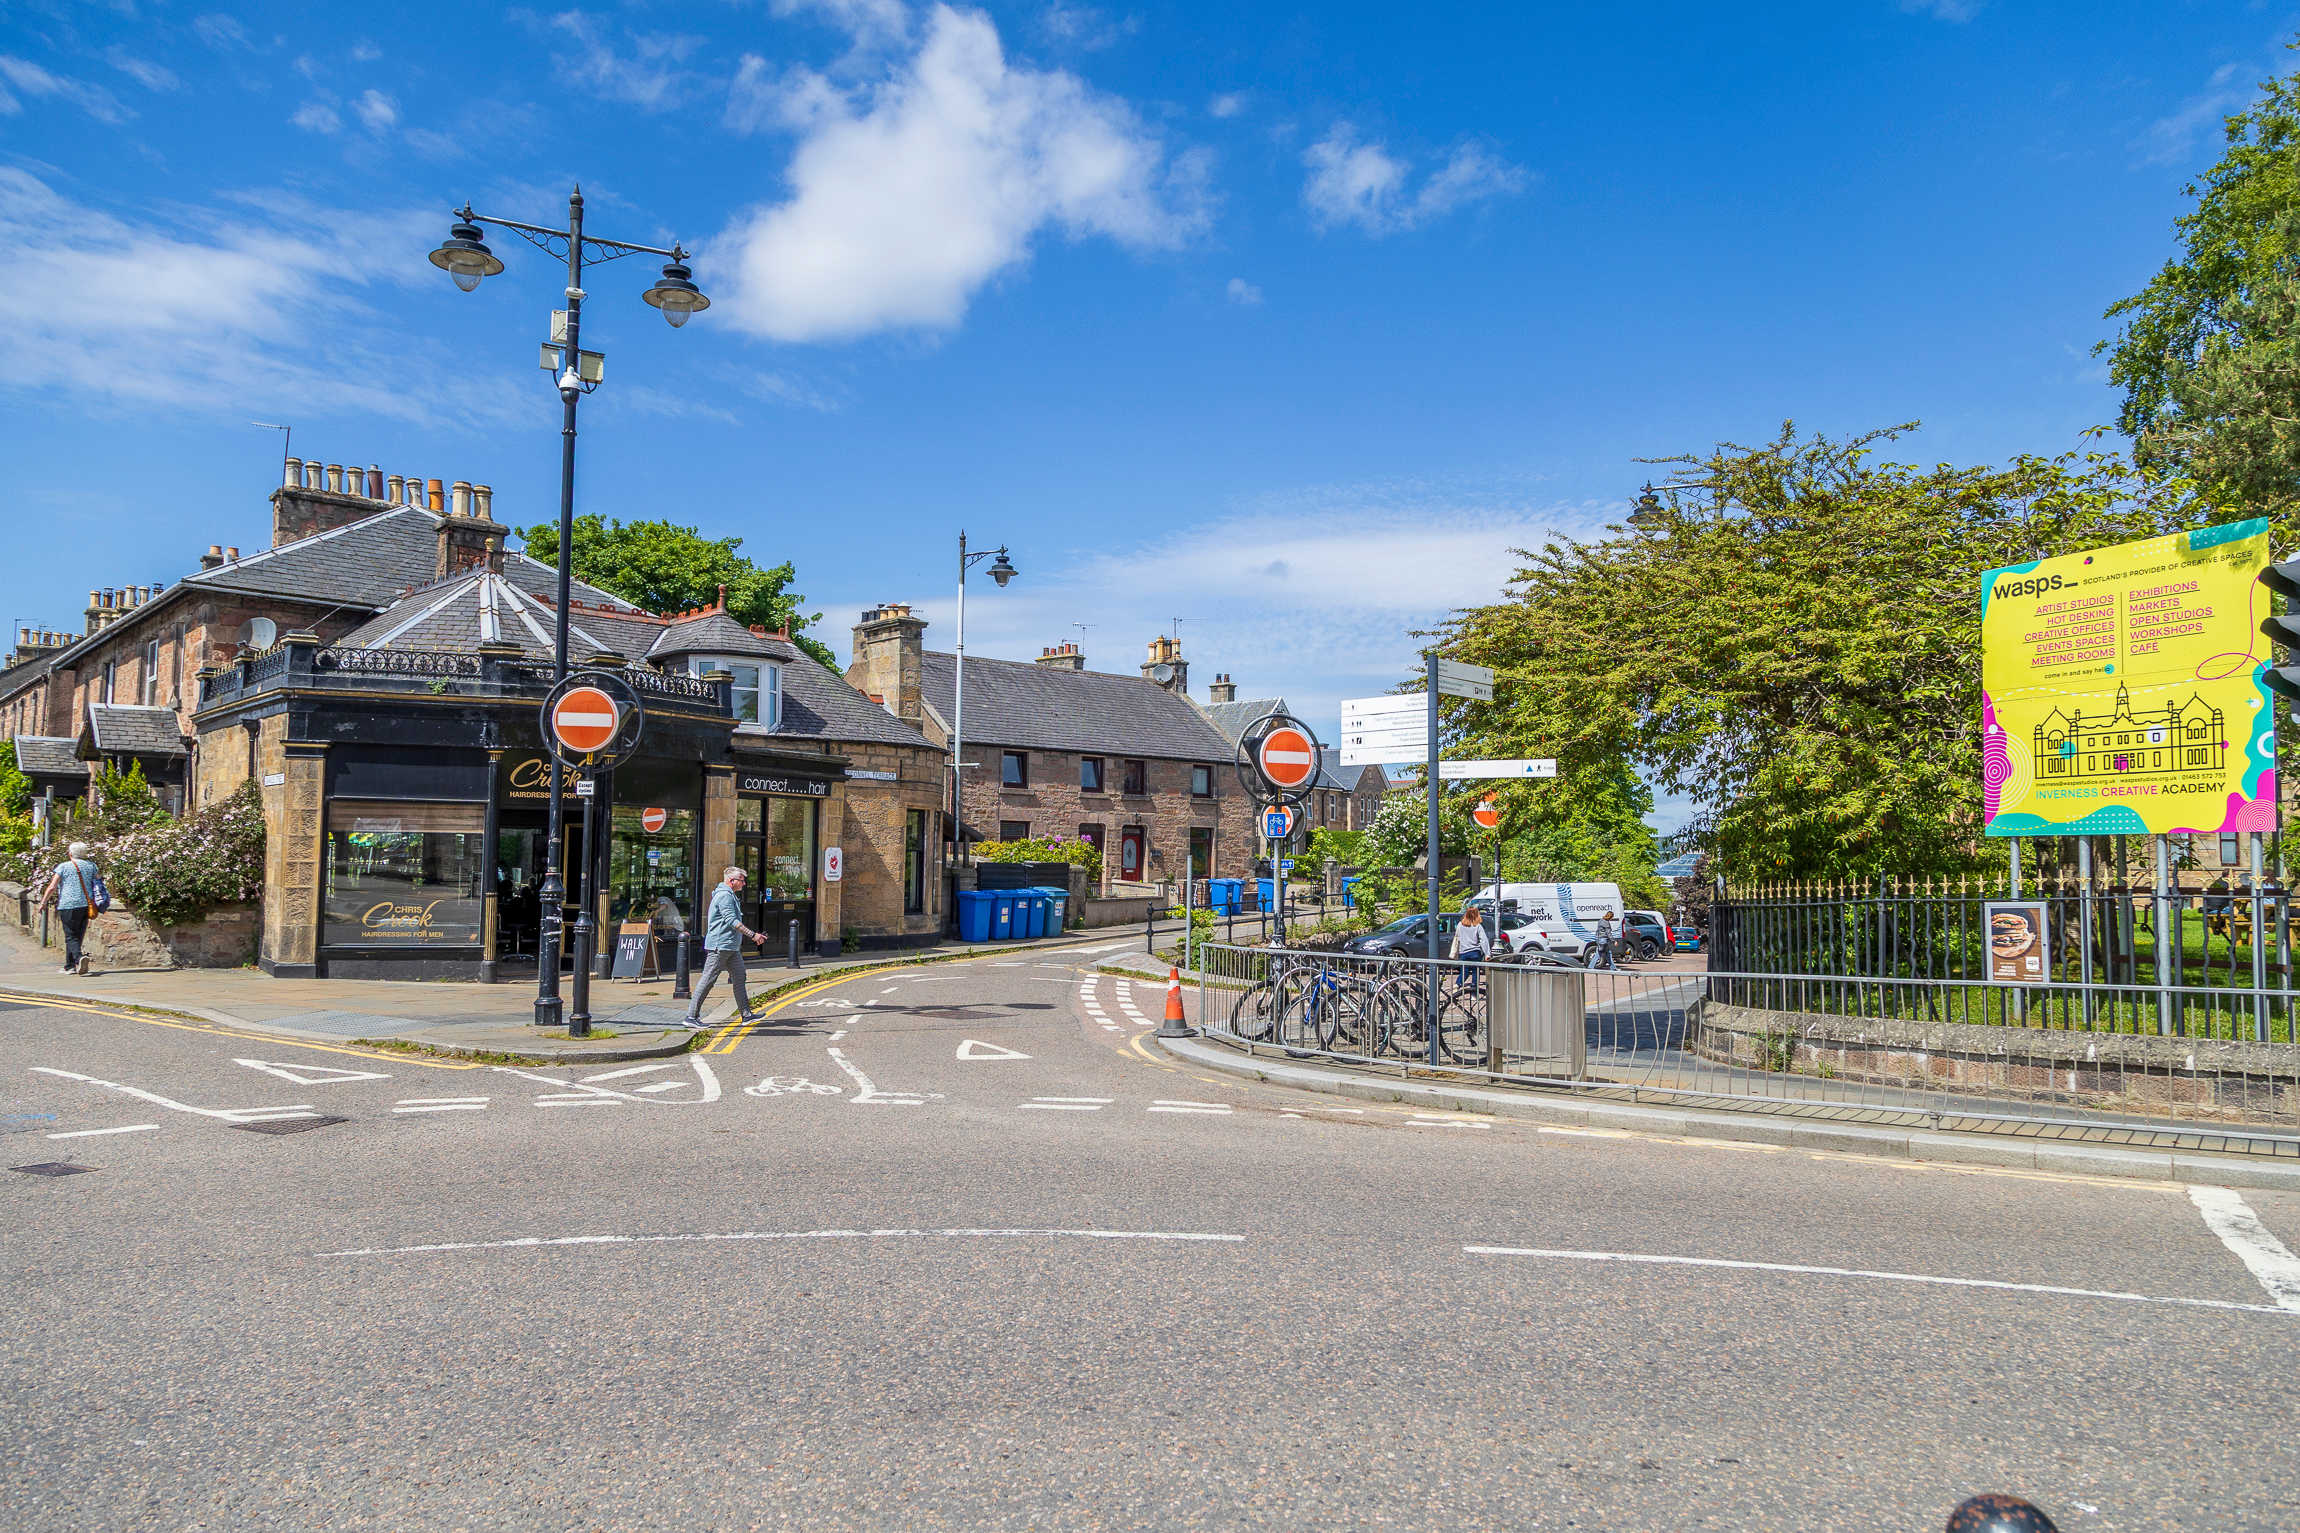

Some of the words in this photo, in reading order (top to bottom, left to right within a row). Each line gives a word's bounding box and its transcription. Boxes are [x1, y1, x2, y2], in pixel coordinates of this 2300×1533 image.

[2083, 572, 2127, 585] SCOTLAND'S
[2129, 565, 2166, 577] PROVIDER
[2168, 562, 2179, 571] OF
[2181, 556, 2217, 569] CREATIVE
[2220, 550, 2253, 562] SPACES
[2129, 580, 2198, 600] EXHIBITIONS
[2036, 601, 2067, 615] ARTIST
[2070, 594, 2114, 609] STUDIOS
[2129, 597, 2180, 613] MARKETS
[2047, 615, 2066, 625] HOT
[2069, 608, 2114, 622] DESKING
[2129, 615, 2160, 626] OPEN
[2163, 606, 2213, 622] STUDIOS
[2024, 628, 2069, 641] CREATIVE
[2071, 621, 2115, 635] OFFICES
[2130, 622, 2203, 640] WORKSHOPS
[2036, 640, 2073, 652] EVENTS
[2075, 634, 2115, 647] SPACES
[2032, 653, 2074, 666] MEETING
[2077, 647, 2115, 660] ROOMS
[808, 780, 826, 795] hair
[2035, 788, 2098, 799] INVERNESS
[2101, 785, 2158, 797] CREATIVE
[2162, 782, 2225, 795] ACADEMY
[1531, 907, 1545, 915] net
[1576, 904, 1613, 912] openreach
[620, 937, 645, 950] WALK
[625, 949, 635, 961] IN
